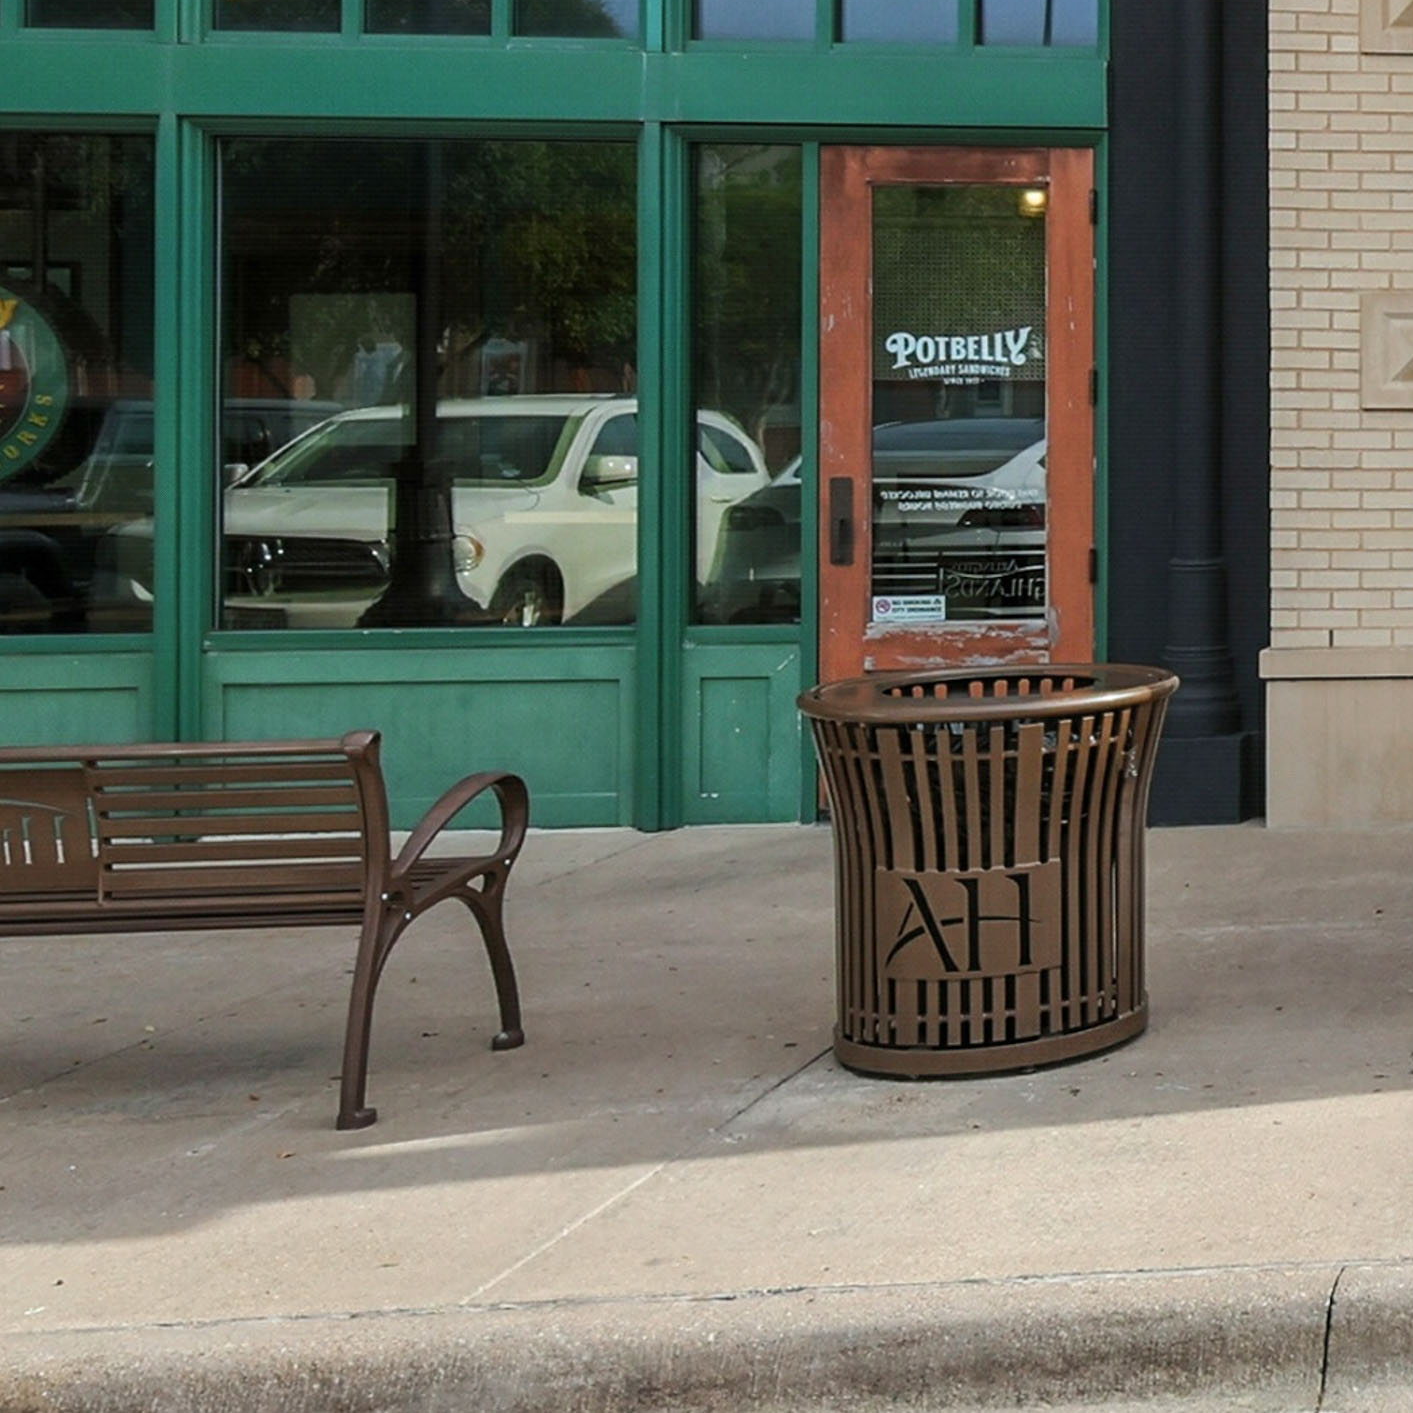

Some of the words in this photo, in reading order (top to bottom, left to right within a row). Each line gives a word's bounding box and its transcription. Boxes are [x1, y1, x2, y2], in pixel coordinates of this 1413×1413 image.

[885, 326, 1033, 369] POTBELLY
[2, 393, 53, 460] ORKS
[885, 873, 1042, 972] AH
